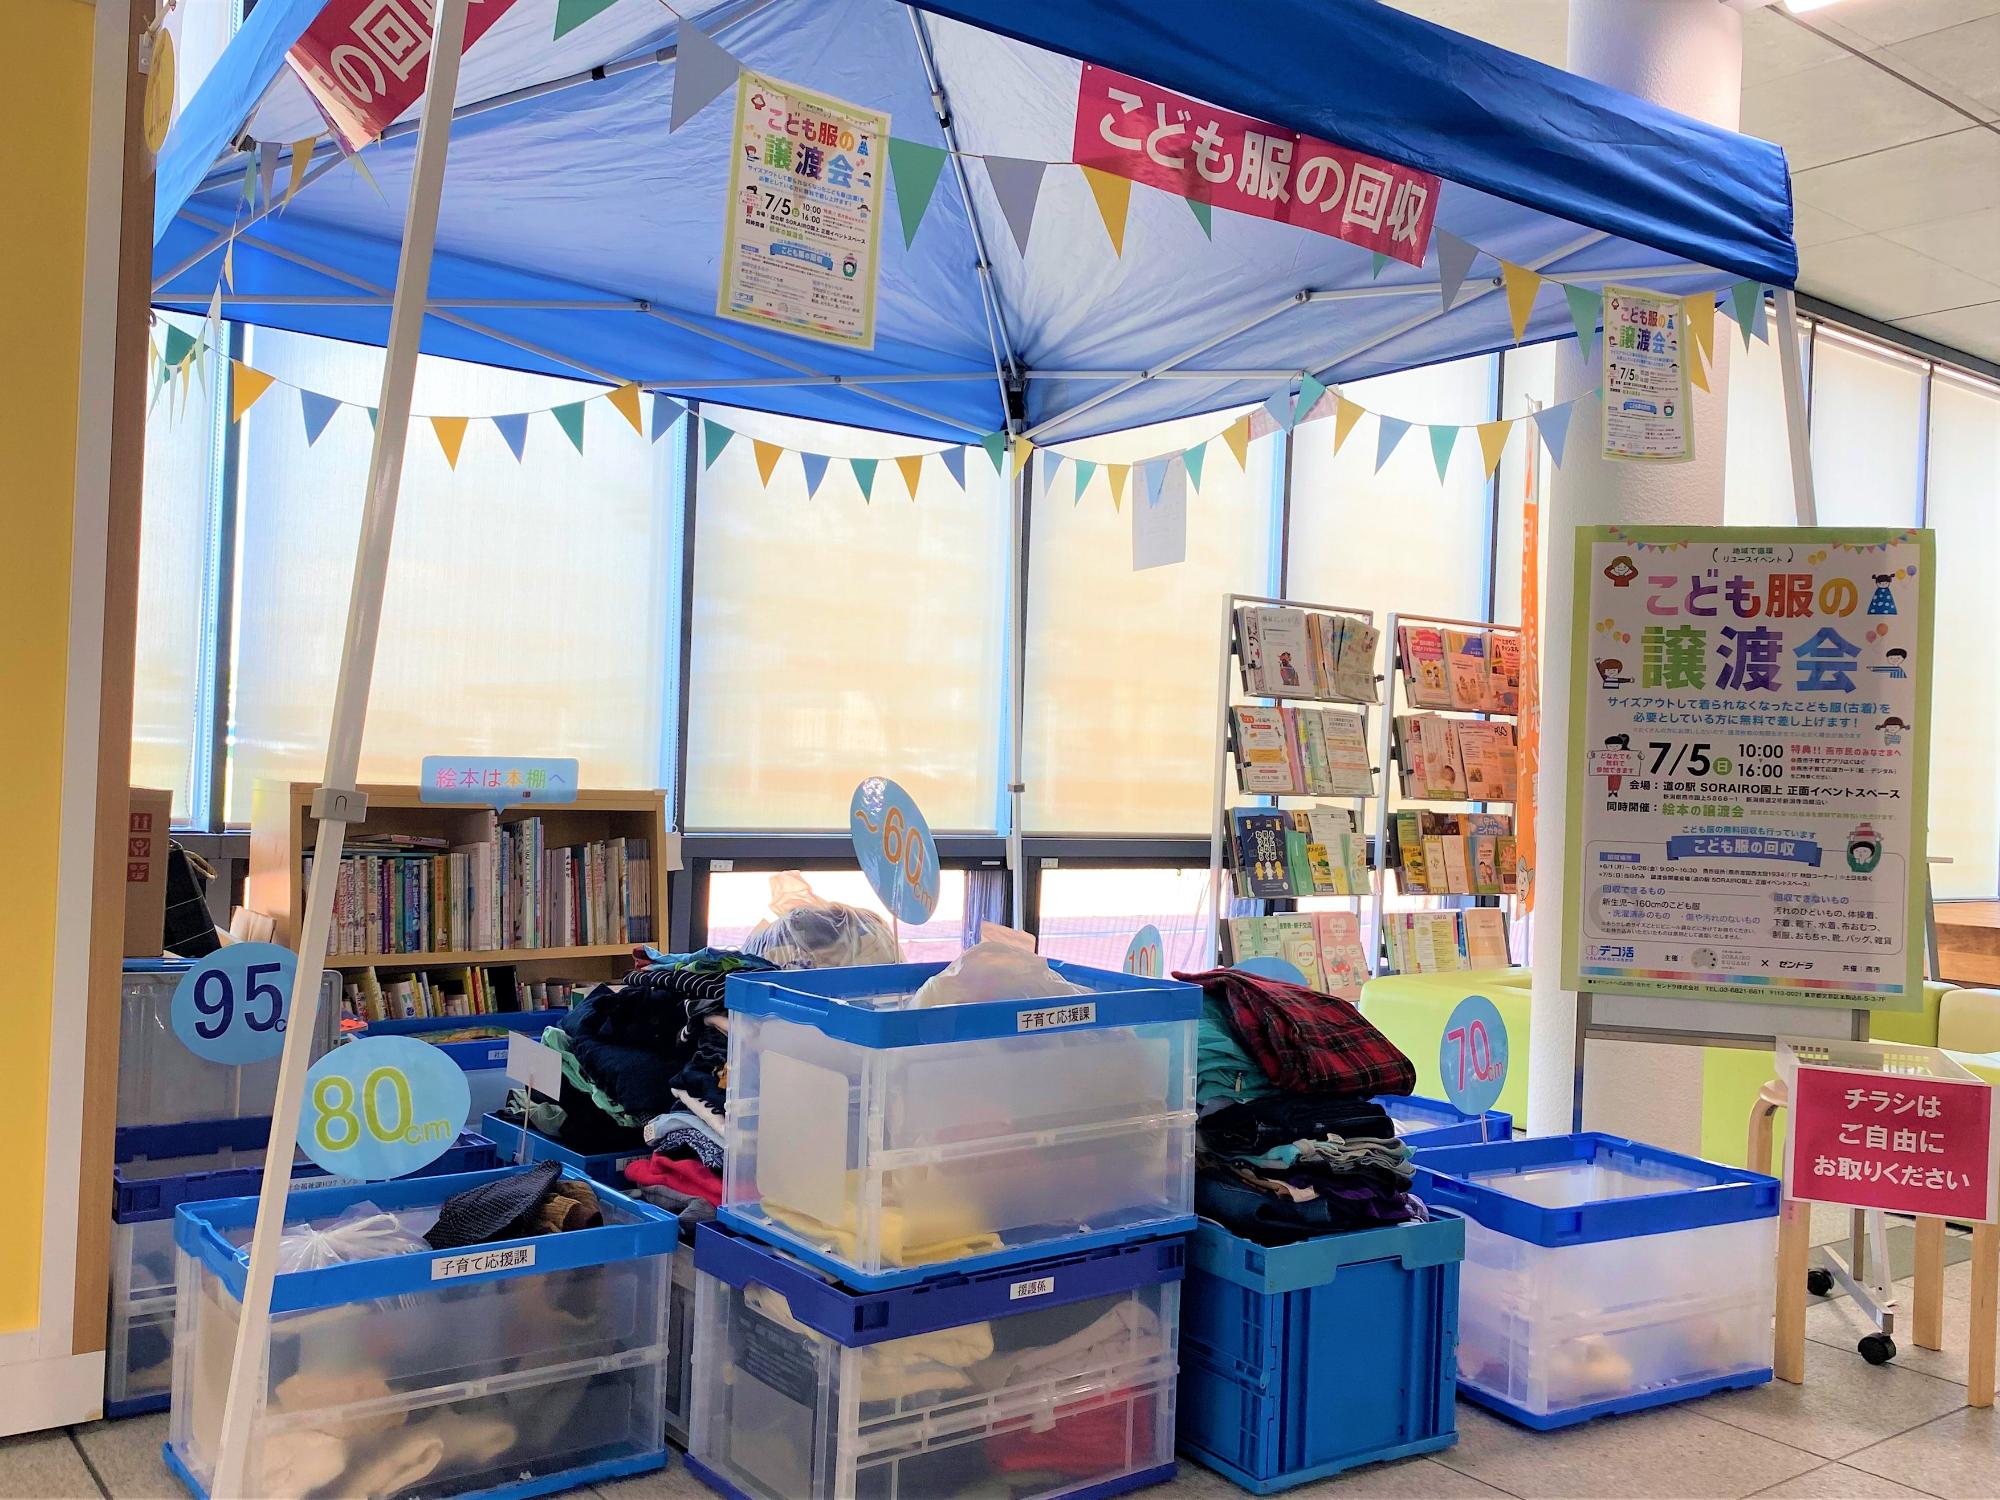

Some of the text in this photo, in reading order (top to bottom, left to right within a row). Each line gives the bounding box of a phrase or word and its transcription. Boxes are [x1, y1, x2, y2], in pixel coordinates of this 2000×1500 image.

[768, 108, 854, 151] こども服の
[764, 133, 854, 188] 譲渡会
[1100, 87, 1428, 246] こども服の回収
[765, 193, 791, 215] 7/5
[1621, 306, 1665, 329] こども服の
[1619, 325, 1665, 354] 譲渡会
[1620, 367, 1635, 381] 7/5
[1646, 569, 1858, 618] こども服の
[1641, 625, 1862, 694] 譲渡会
[1648, 742, 1711, 776] 7/5
[1738, 743, 1783, 758] 10:00
[436, 768, 565, 789] 絵本は本棚へ
[1738, 763, 1783, 778] 16:00
[1663, 781, 1695, 792] 道の駅
[1700, 782, 1783, 795] SORAIRO国上
[1787, 785, 1901, 799] 正面イベントスペース
[1662, 803, 1745, 818] 絵本の譲渡会
[1682, 825, 1816, 839] こども服の無料回収も行っています
[1694, 839, 1795, 857] こども服の回収
[1602, 884, 1665, 895] 回収できるもの
[1773, 893, 1849, 905] 回収できないもの
[1599, 945, 1634, 958] デコ活
[1779, 960, 1814, 969] ゼントラ
[1021, 1006, 1090, 1029] 子育て応援課
[1844, 1088, 1942, 1119] チラシは
[1838, 1122, 1945, 1154] ご自由に
[1813, 1154, 1970, 1191] お取りください
[441, 1249, 529, 1276] 子育て応援課
[1017, 1280, 1046, 1296] 援護係
